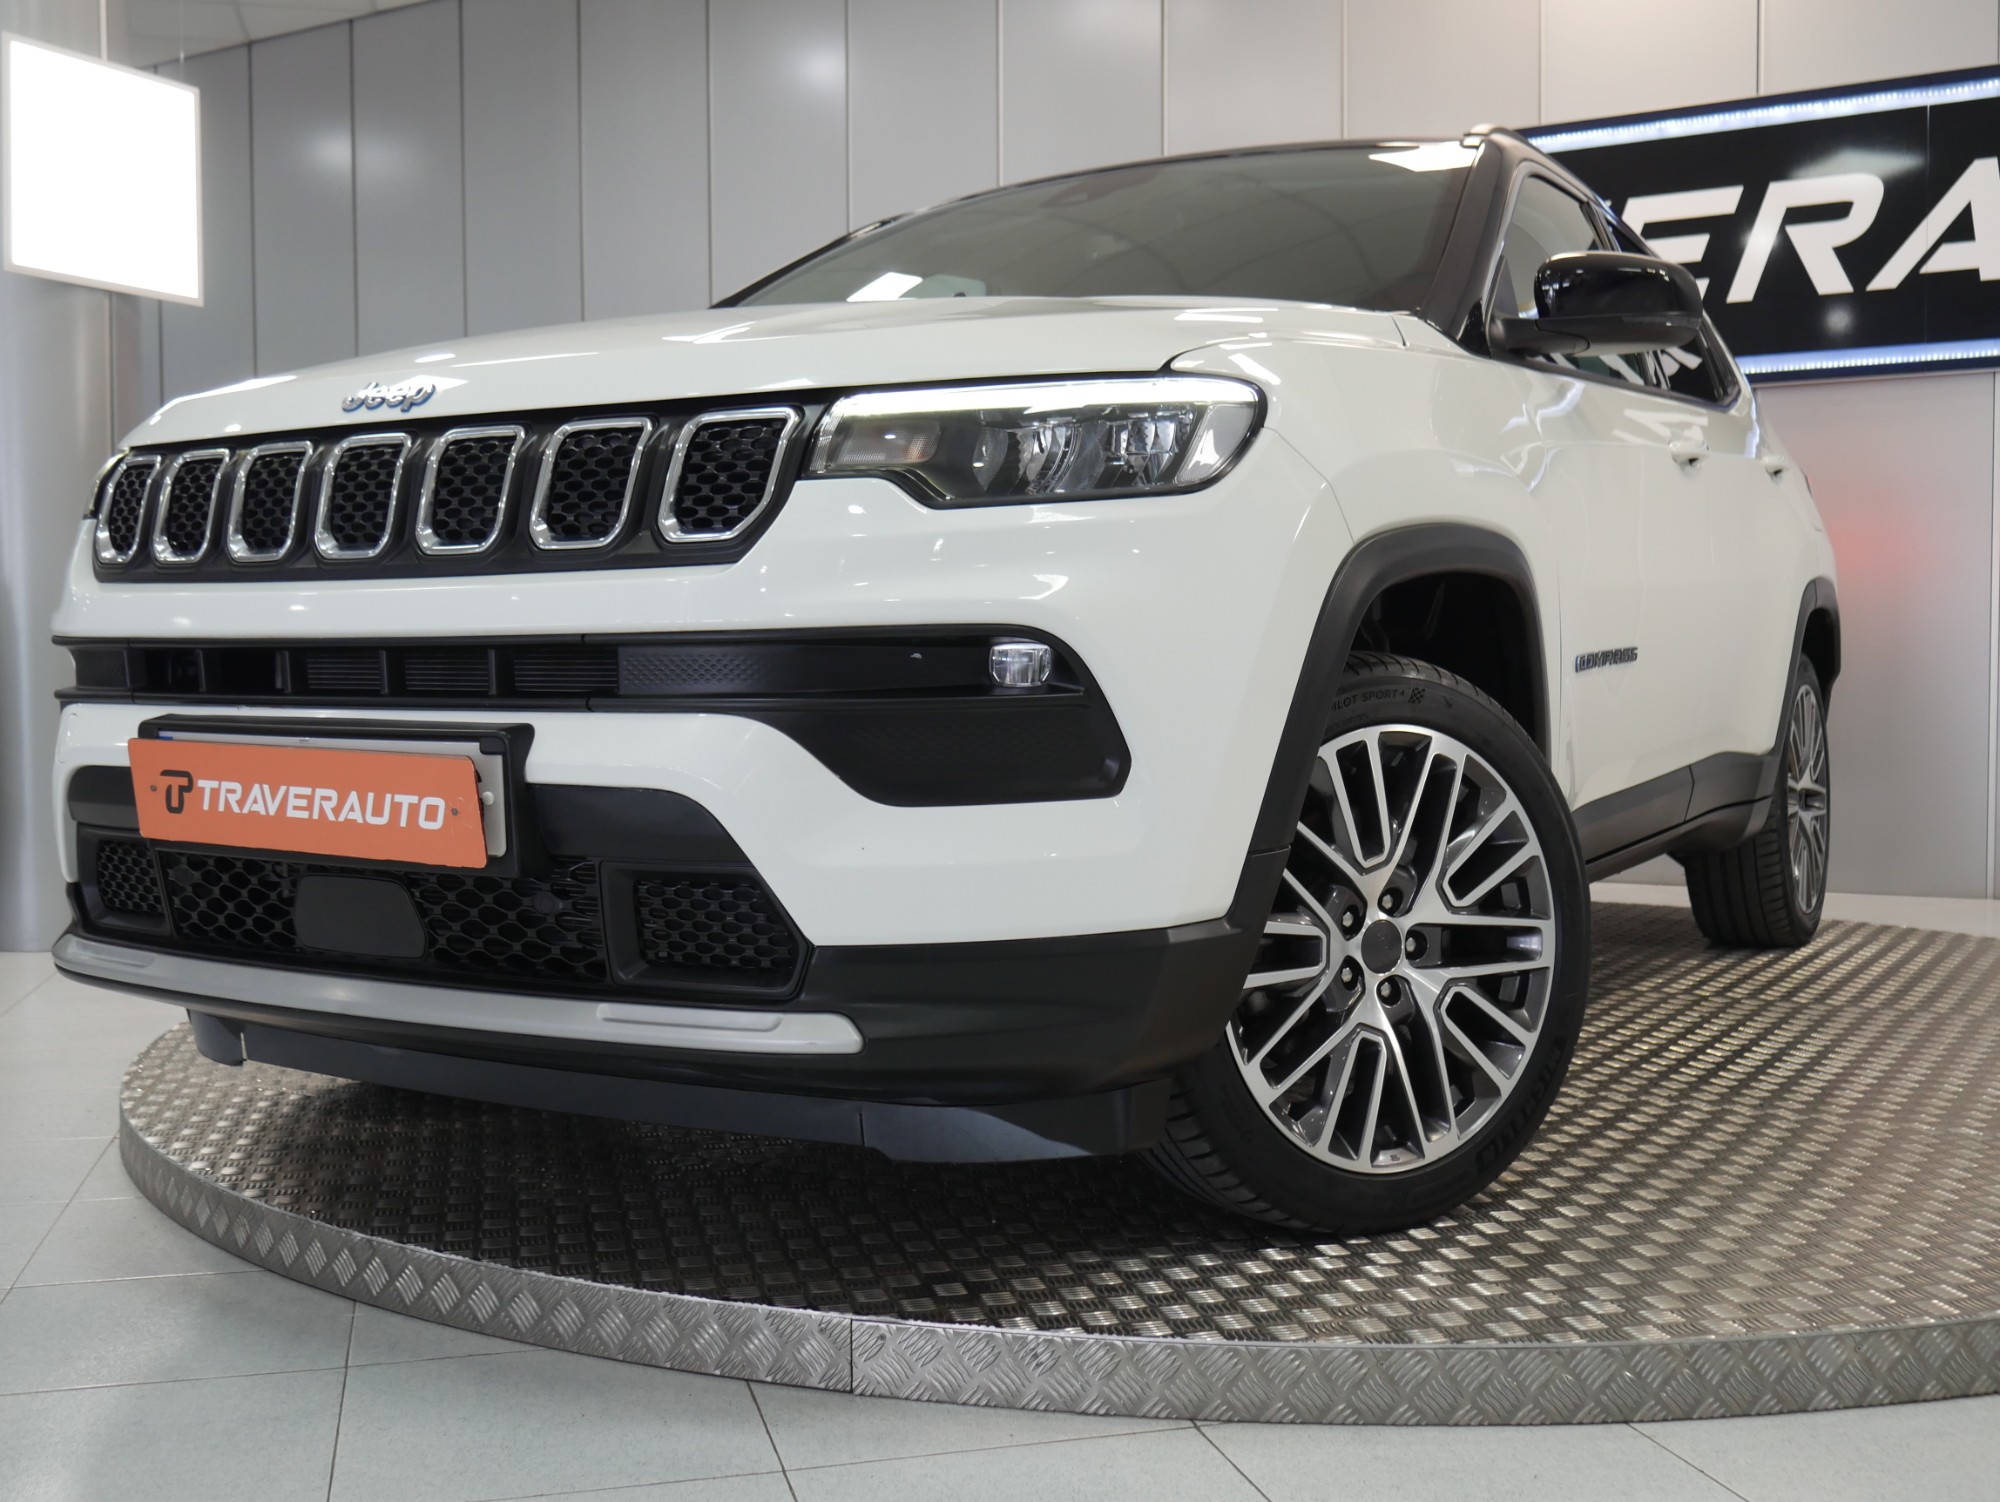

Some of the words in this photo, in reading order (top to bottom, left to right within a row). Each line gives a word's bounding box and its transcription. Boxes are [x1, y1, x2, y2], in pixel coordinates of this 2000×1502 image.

[341, 382, 436, 413] Jeep
[1575, 647, 1638, 673] COMPASS
[1362, 689, 1399, 702] SPORT
[197, 778, 446, 830] TRAVERAUTO
